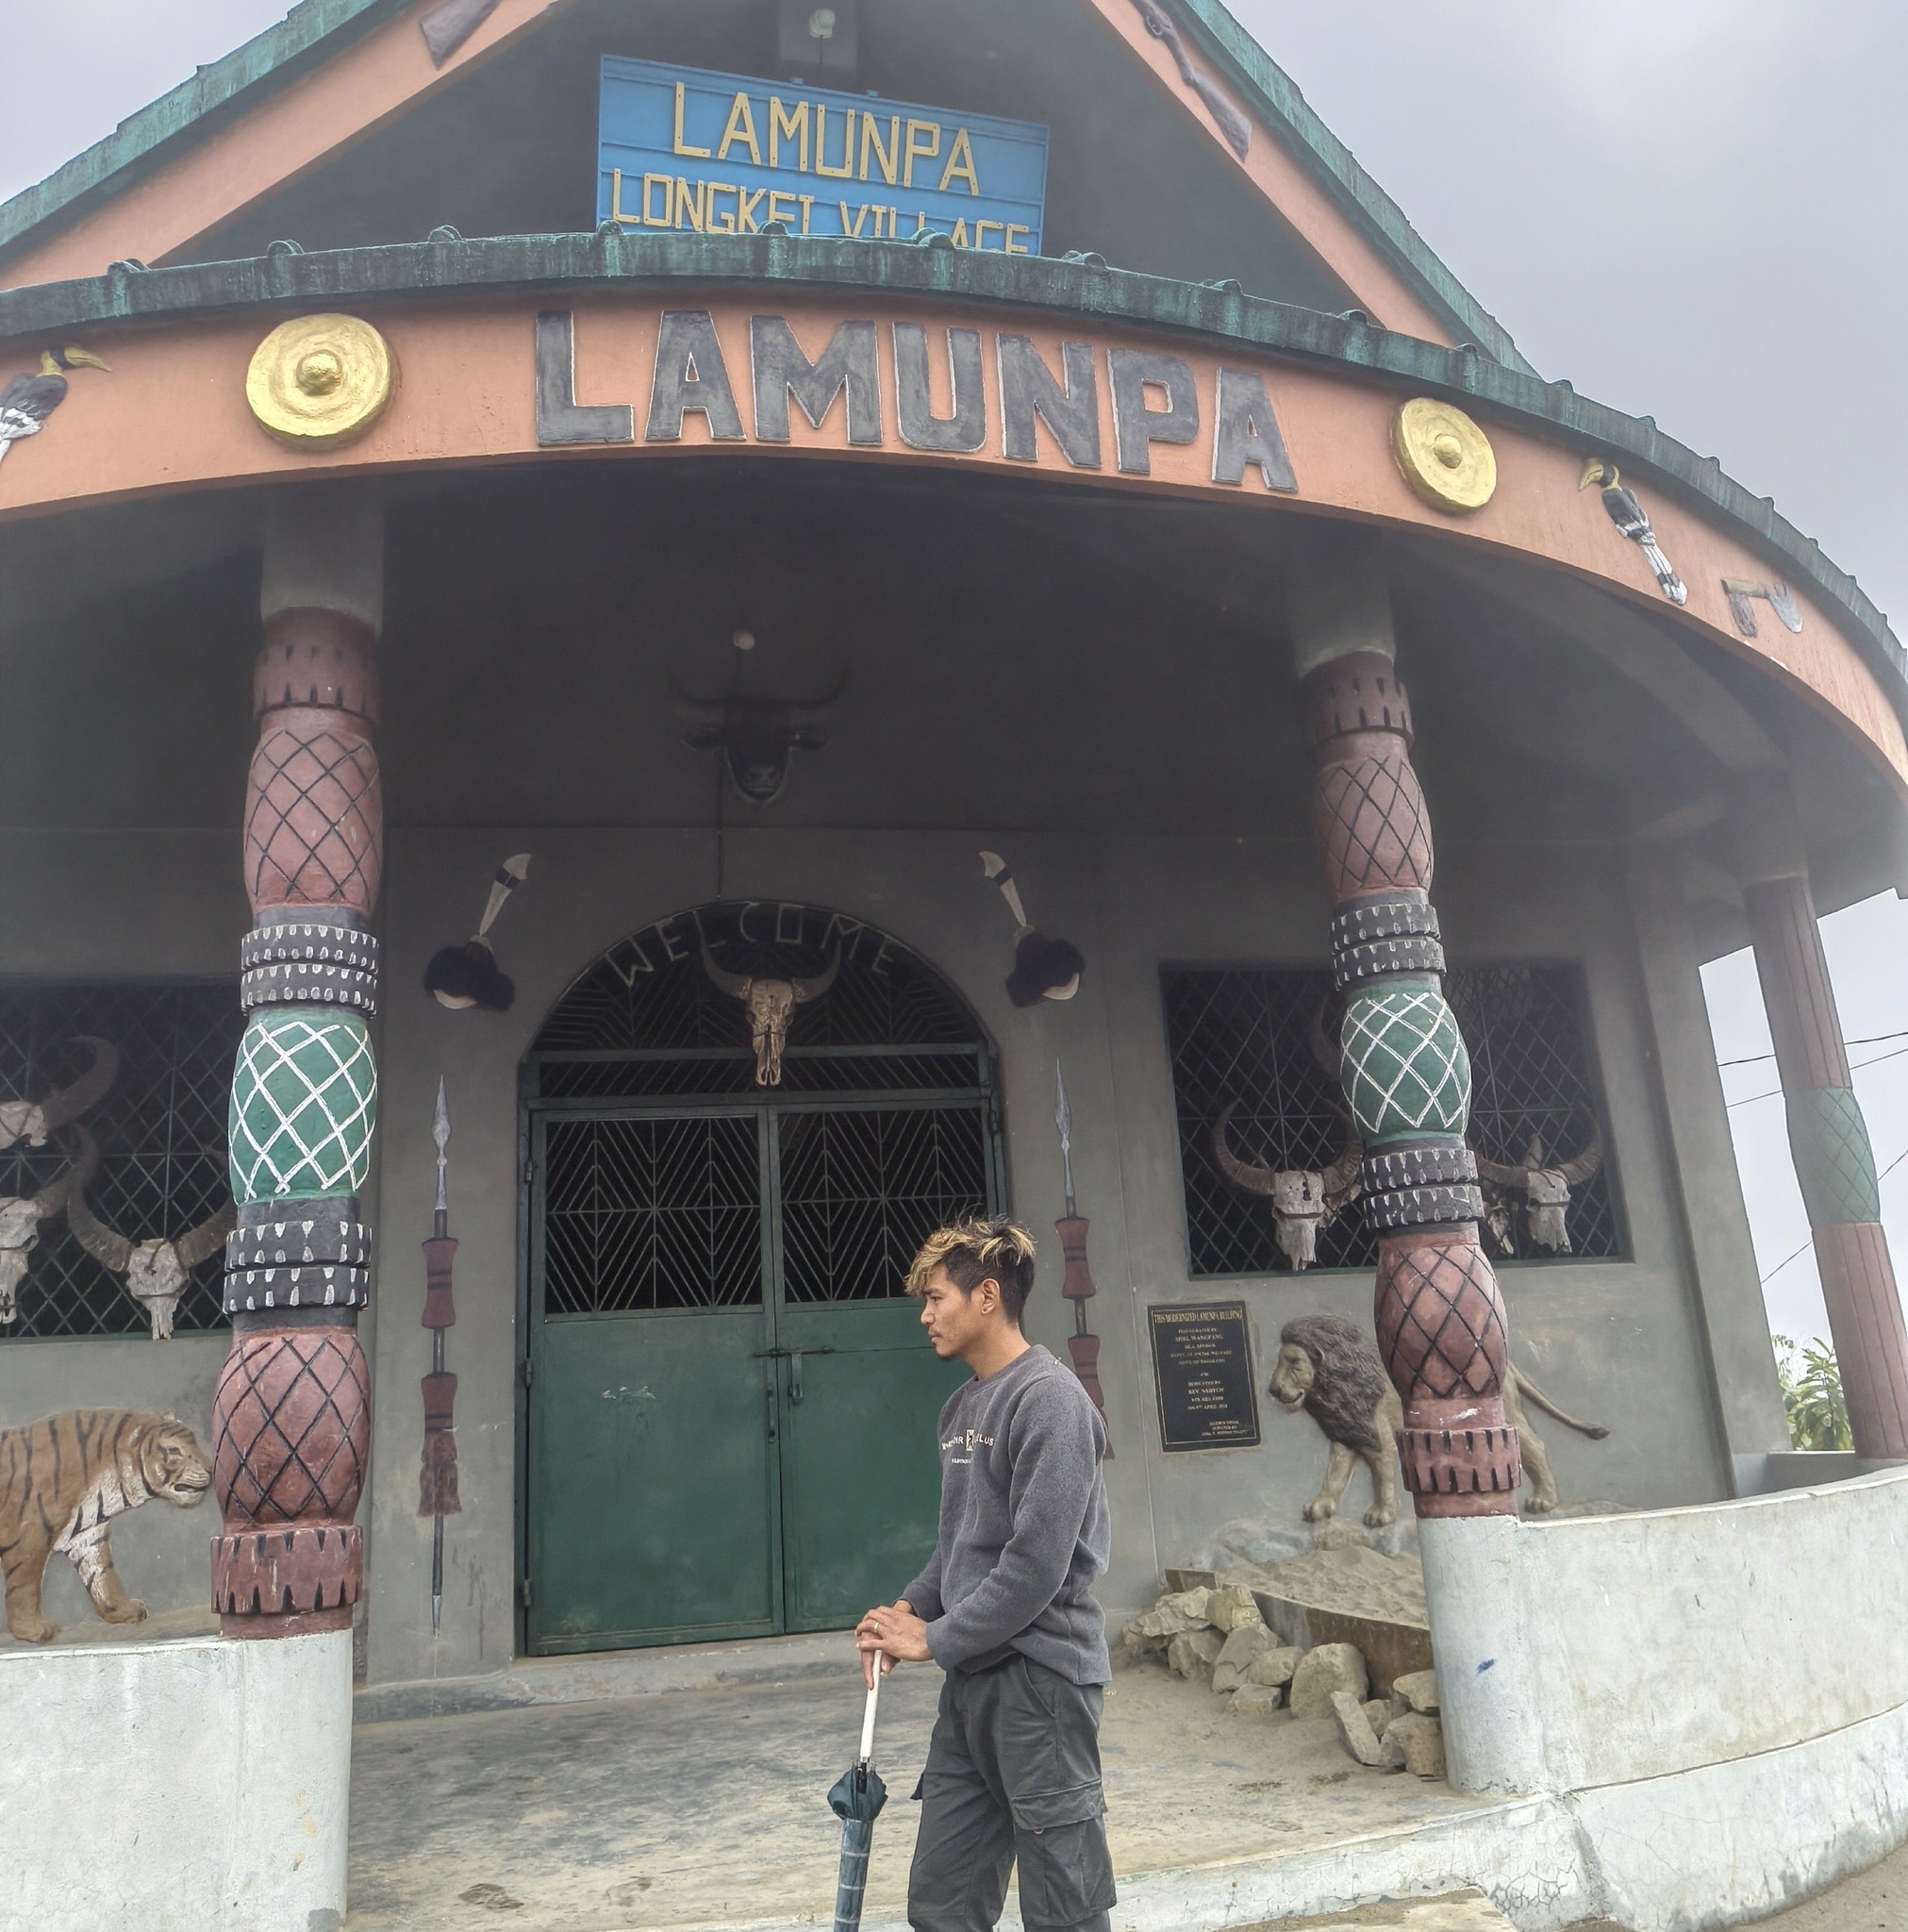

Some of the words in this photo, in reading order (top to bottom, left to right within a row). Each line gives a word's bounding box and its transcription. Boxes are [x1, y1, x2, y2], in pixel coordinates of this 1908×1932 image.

[673, 81, 979, 195] LAMUNPA
[535, 309, 1301, 493] LAMUNPA
[605, 901, 895, 988] WELCOME
